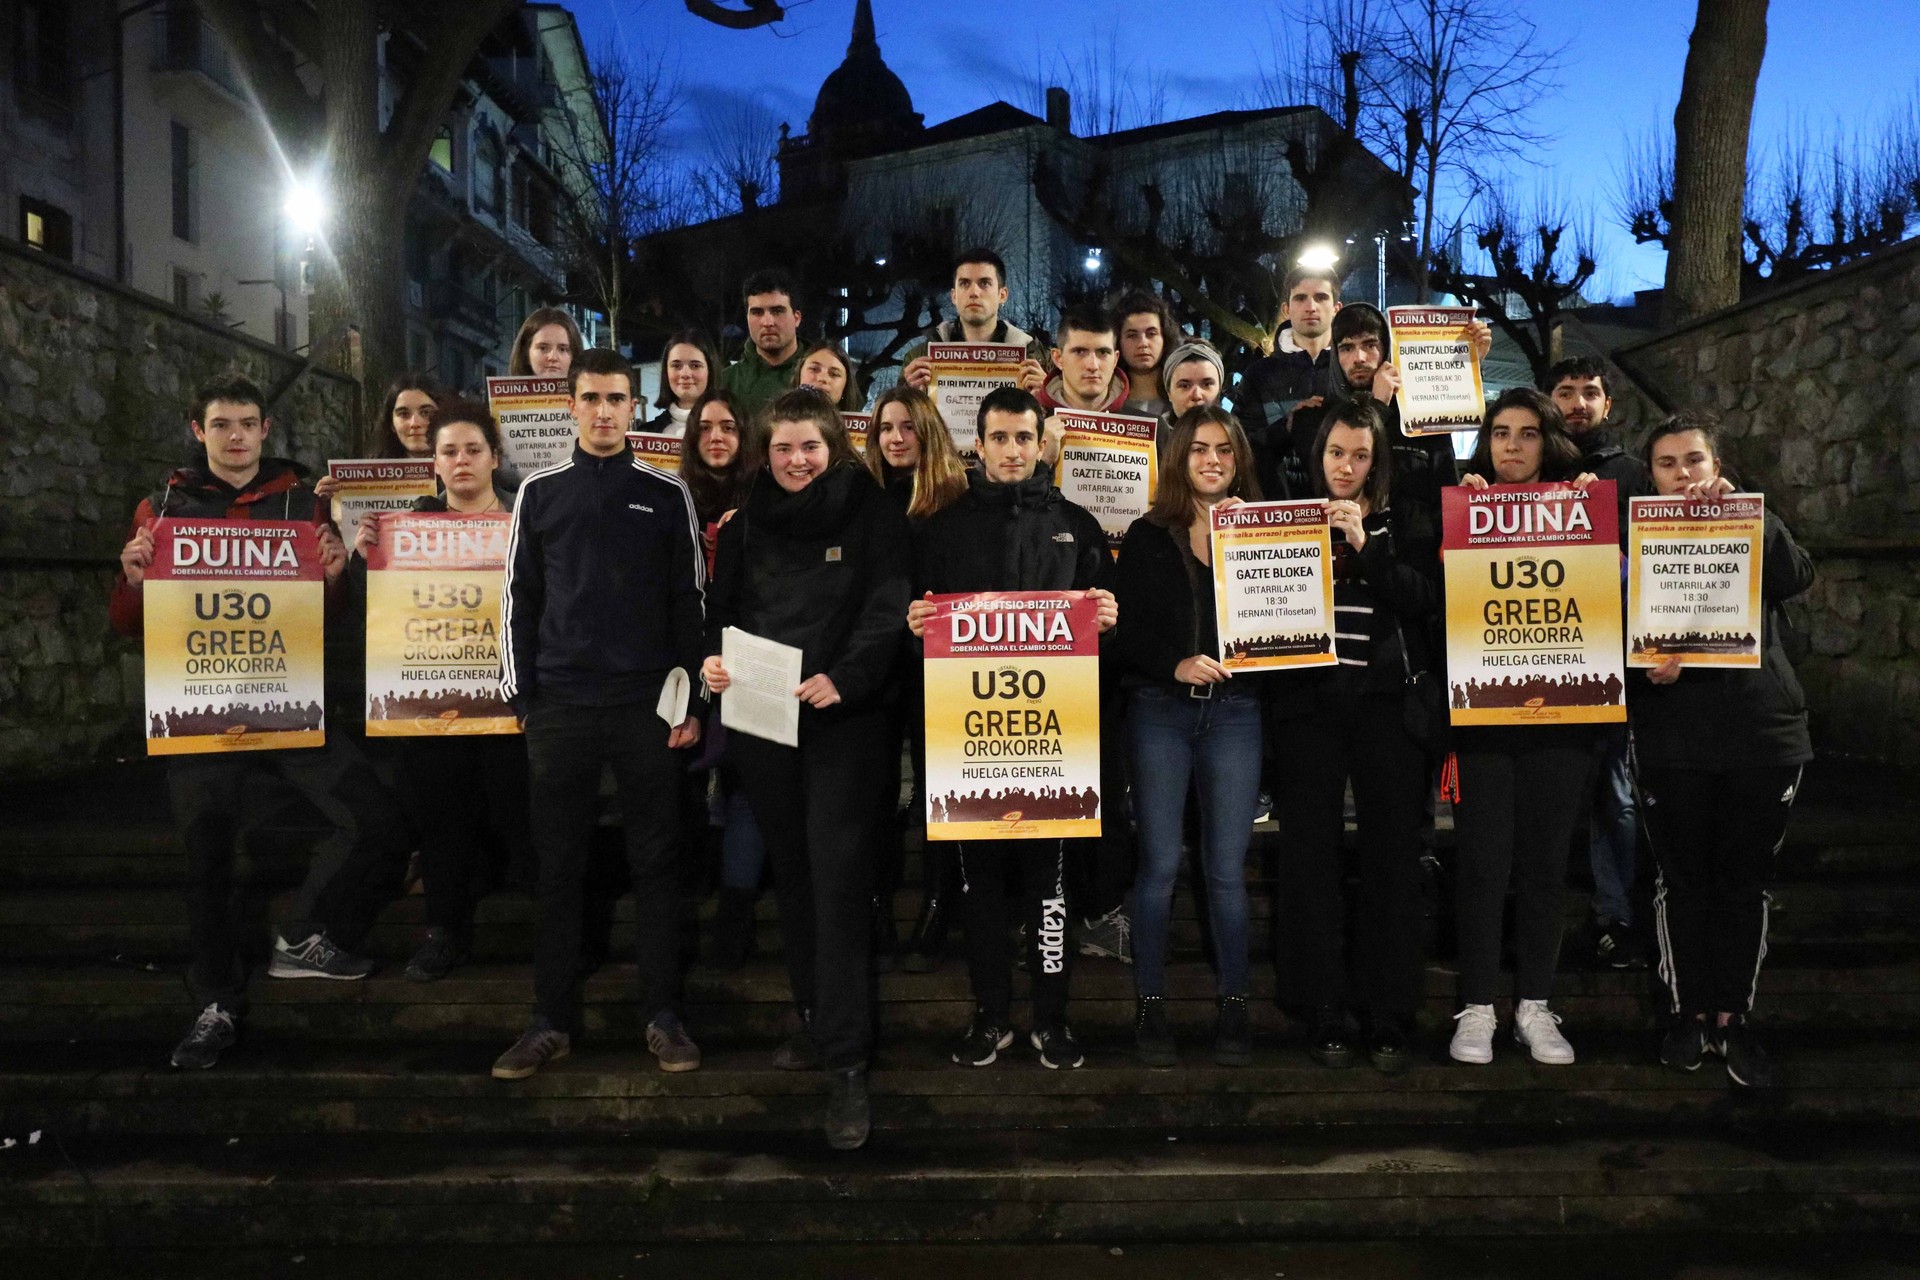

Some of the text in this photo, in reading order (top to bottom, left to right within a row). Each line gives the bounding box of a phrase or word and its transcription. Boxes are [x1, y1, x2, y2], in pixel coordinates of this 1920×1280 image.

[1395, 315, 1426, 324] DUINA
[1428, 314, 1448, 324] U30
[934, 351, 969, 360] DUINA
[972, 350, 996, 360] U30
[1400, 345, 1468, 355] BURUNTZALDEAKO
[1408, 360, 1466, 370] GAZTE BLOKEA
[1454, 374, 1462, 382] 30
[494, 385, 529, 394] DUINA
[532, 382, 556, 392] U30
[1432, 384, 1448, 392] 18:30
[844, 420, 866, 430] U30
[1102, 422, 1126, 434] U30
[1126, 424, 1150, 434] GREBA
[509, 428, 572, 438] GAZTE BLOKEA
[516, 442, 556, 450] URTARRILAK
[648, 440, 670, 452] U30
[1064, 450, 1148, 466] BURUNTZALDEAKO
[336, 470, 374, 478] DUINA
[378, 468, 404, 478] U30
[404, 466, 430, 474] GREBA
[510, 462, 540, 470] HERNANI
[1072, 468, 1142, 481] GAZTE BLOKEA
[1078, 484, 1134, 494] URTARRILAK 30
[1095, 495, 1116, 504] 18:30
[1469, 490, 1590, 503] LAN-PENTSIO-BIZITZA
[628, 504, 654, 513] adidas
[1102, 506, 1140, 516] (Tilosetan)
[1638, 502, 1754, 518] DUINA U30 GREBA
[1218, 508, 1322, 526] DUINA U30 GREBA
[1470, 502, 1592, 535] DUINA
[173, 526, 297, 538] LAN-PENTSIO-BIZITZA
[1284, 528, 1322, 538] grebarako
[1710, 524, 1754, 532] grebarako
[394, 530, 507, 558] DUINA
[1468, 536, 1506, 544] SOBERANÍA
[1536, 534, 1564, 542] CAMBIO
[174, 538, 299, 567] DUINA
[1225, 547, 1320, 561] BURUNTZALDEAKO
[1642, 543, 1750, 556] BURUNTZALDEAKO
[172, 568, 213, 576] SOBERANÍA
[215, 568, 234, 576] PARA
[1236, 566, 1314, 580] GAZTE BLOKEA
[1490, 559, 1566, 590] U30
[1653, 563, 1740, 574] GAZTE BLOKEA
[1244, 584, 1307, 594] URTARRILAK 30
[1660, 580, 1730, 590] URTARRILAK 30
[412, 583, 482, 609] U30
[1266, 596, 1288, 606] 18:30
[1683, 593, 1708, 602] 18:30
[194, 593, 272, 621] U30
[951, 600, 1071, 611] LAN-PENTSIO-BIZITZA
[1650, 604, 1740, 614] HERNANI (Tilosetan)
[1238, 607, 1316, 618] HERNANI (Tilosetan)
[1484, 598, 1582, 626] GREBA
[404, 618, 497, 642] GREBA
[951, 612, 1074, 643] DUINA
[1484, 626, 1584, 645] OROKORRA
[186, 629, 287, 656] GREBA
[950, 645, 989, 653] SOBERANÍA
[990, 644, 1008, 652] PARA
[1010, 644, 1018, 652] EL
[404, 644, 498, 660] OROKORRA
[186, 657, 287, 674] OROKORRA
[1482, 654, 1586, 667] HUELGA GENERAL
[402, 669, 500, 680] HUELGA GENERAL
[184, 682, 288, 696] HUELGA GENERAL
[972, 670, 1046, 700] U30
[964, 710, 1062, 738] GREBA
[964, 738, 1062, 757] OROKORRA
[962, 766, 1064, 779] HUELGA GENERAL
[1038, 898, 1066, 974] Kappa
